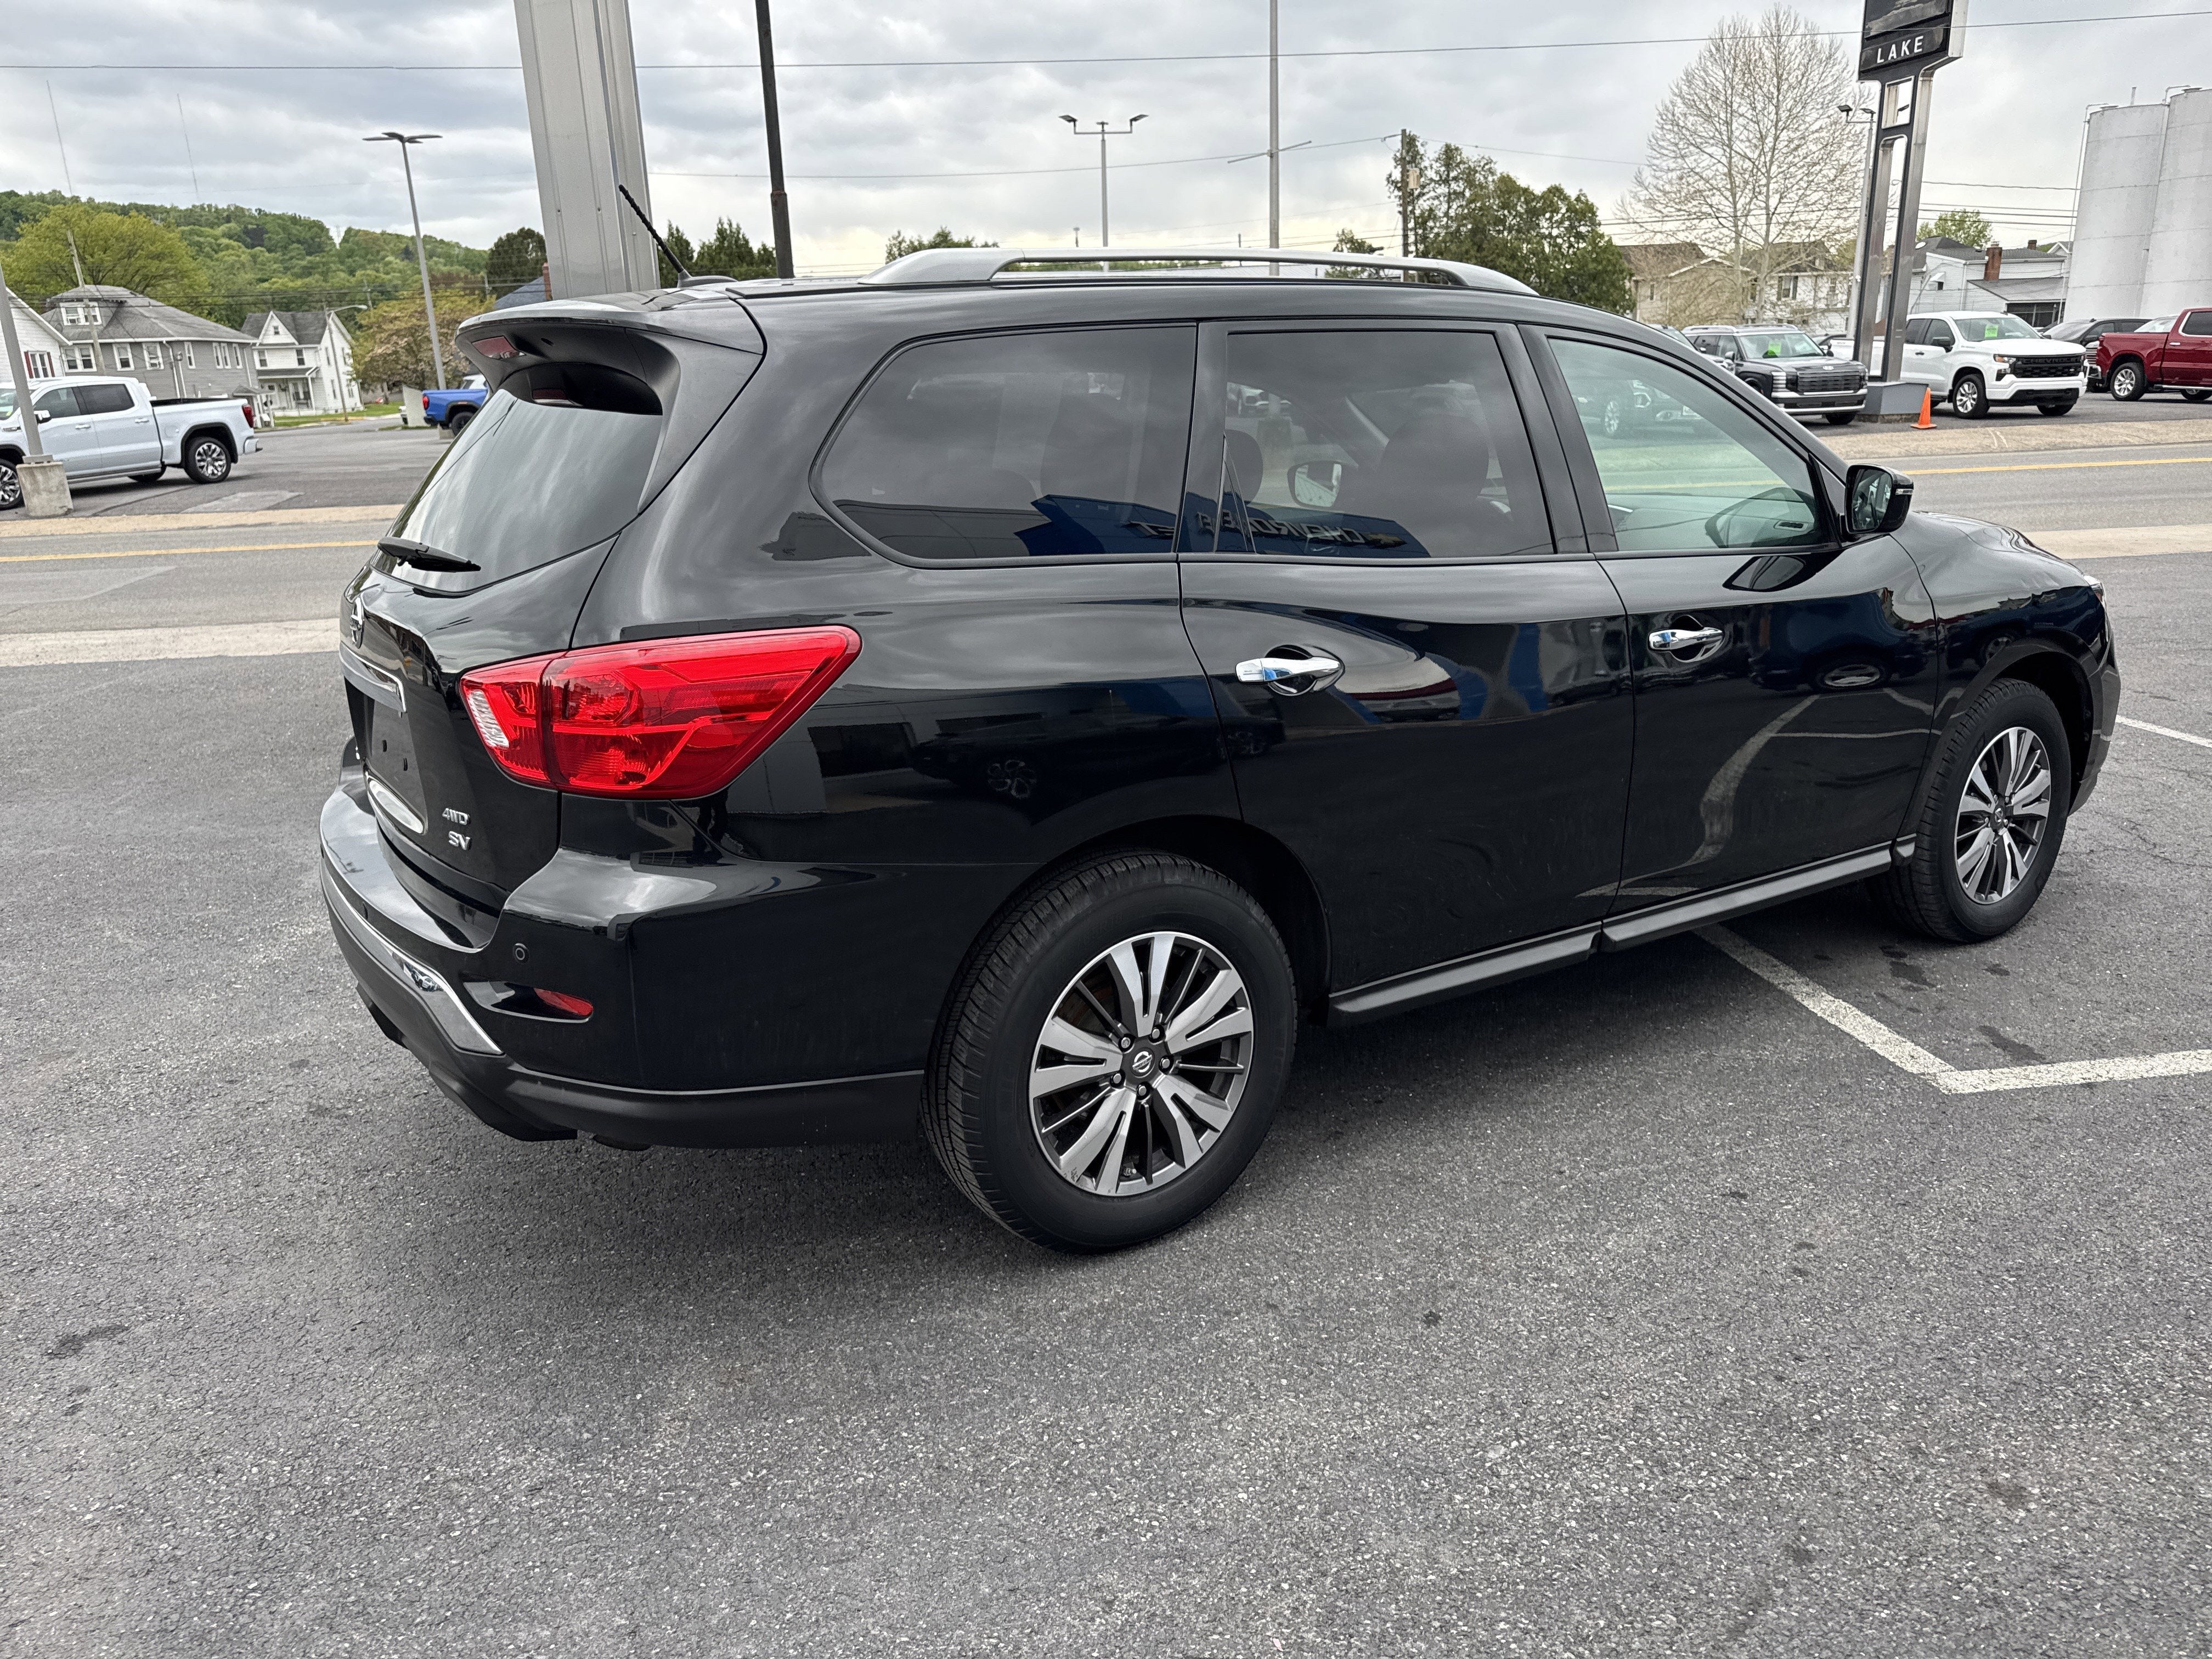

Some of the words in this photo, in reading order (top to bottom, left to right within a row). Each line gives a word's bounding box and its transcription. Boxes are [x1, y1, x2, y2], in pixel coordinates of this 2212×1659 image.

[1877, 35, 1924, 64] LAKE
[442, 808, 469, 825] 4WD
[448, 831, 471, 850] SV
